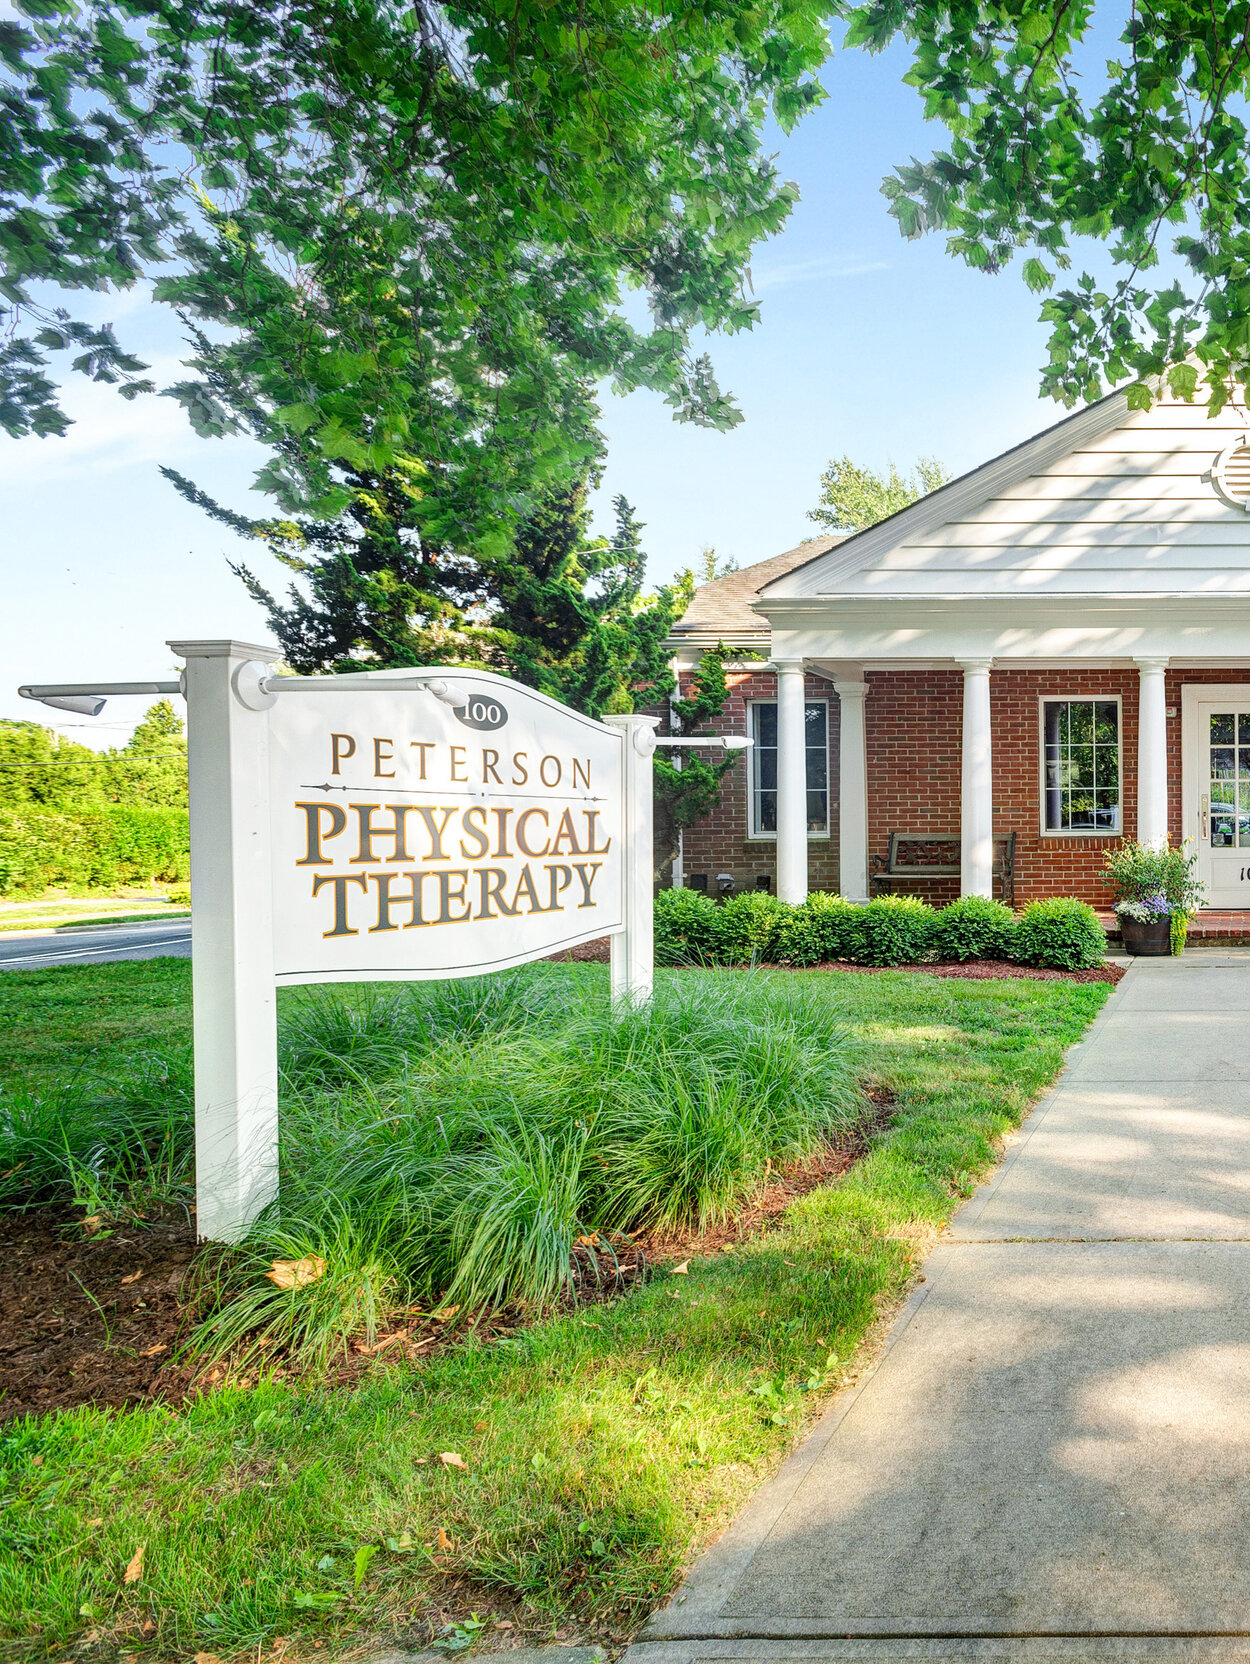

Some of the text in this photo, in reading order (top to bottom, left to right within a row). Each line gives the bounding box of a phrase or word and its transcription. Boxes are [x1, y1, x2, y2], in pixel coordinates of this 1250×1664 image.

[462, 702, 501, 724] 100
[331, 733, 592, 790] PETERSON
[295, 801, 611, 866] PHYSICAL
[313, 862, 603, 939] THERAPY
